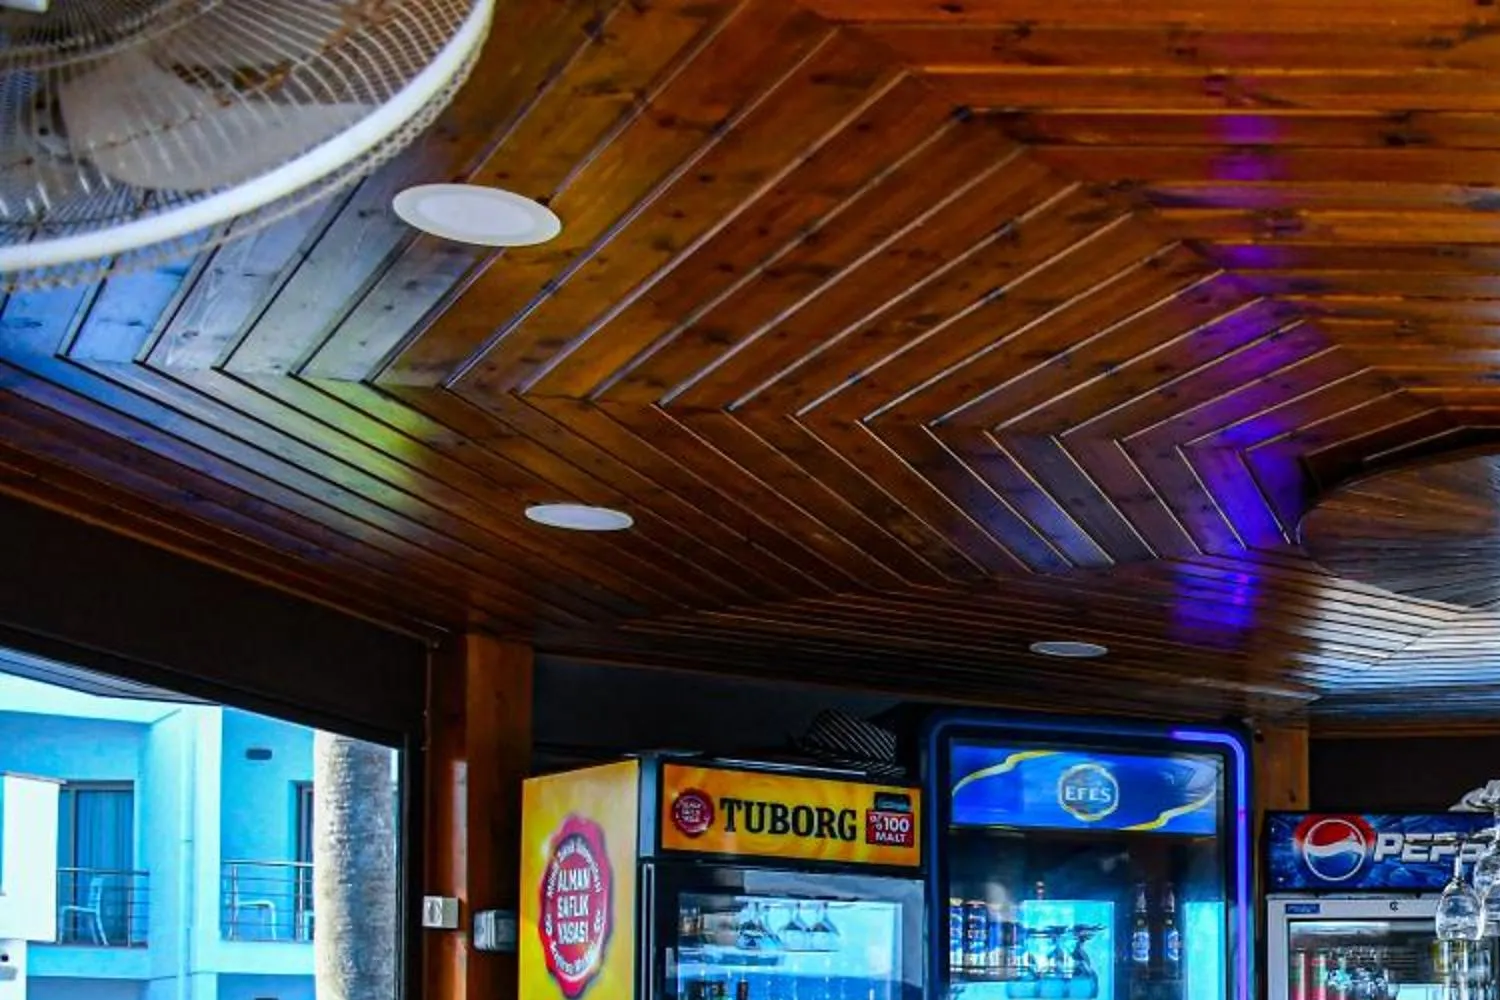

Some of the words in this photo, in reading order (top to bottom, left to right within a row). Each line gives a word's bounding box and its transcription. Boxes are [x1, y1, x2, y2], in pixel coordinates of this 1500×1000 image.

[1064, 785, 1111, 802] EFES
[719, 797, 857, 842] TUBORG
[869, 814, 910, 833] %100
[875, 832, 906, 844] MALT
